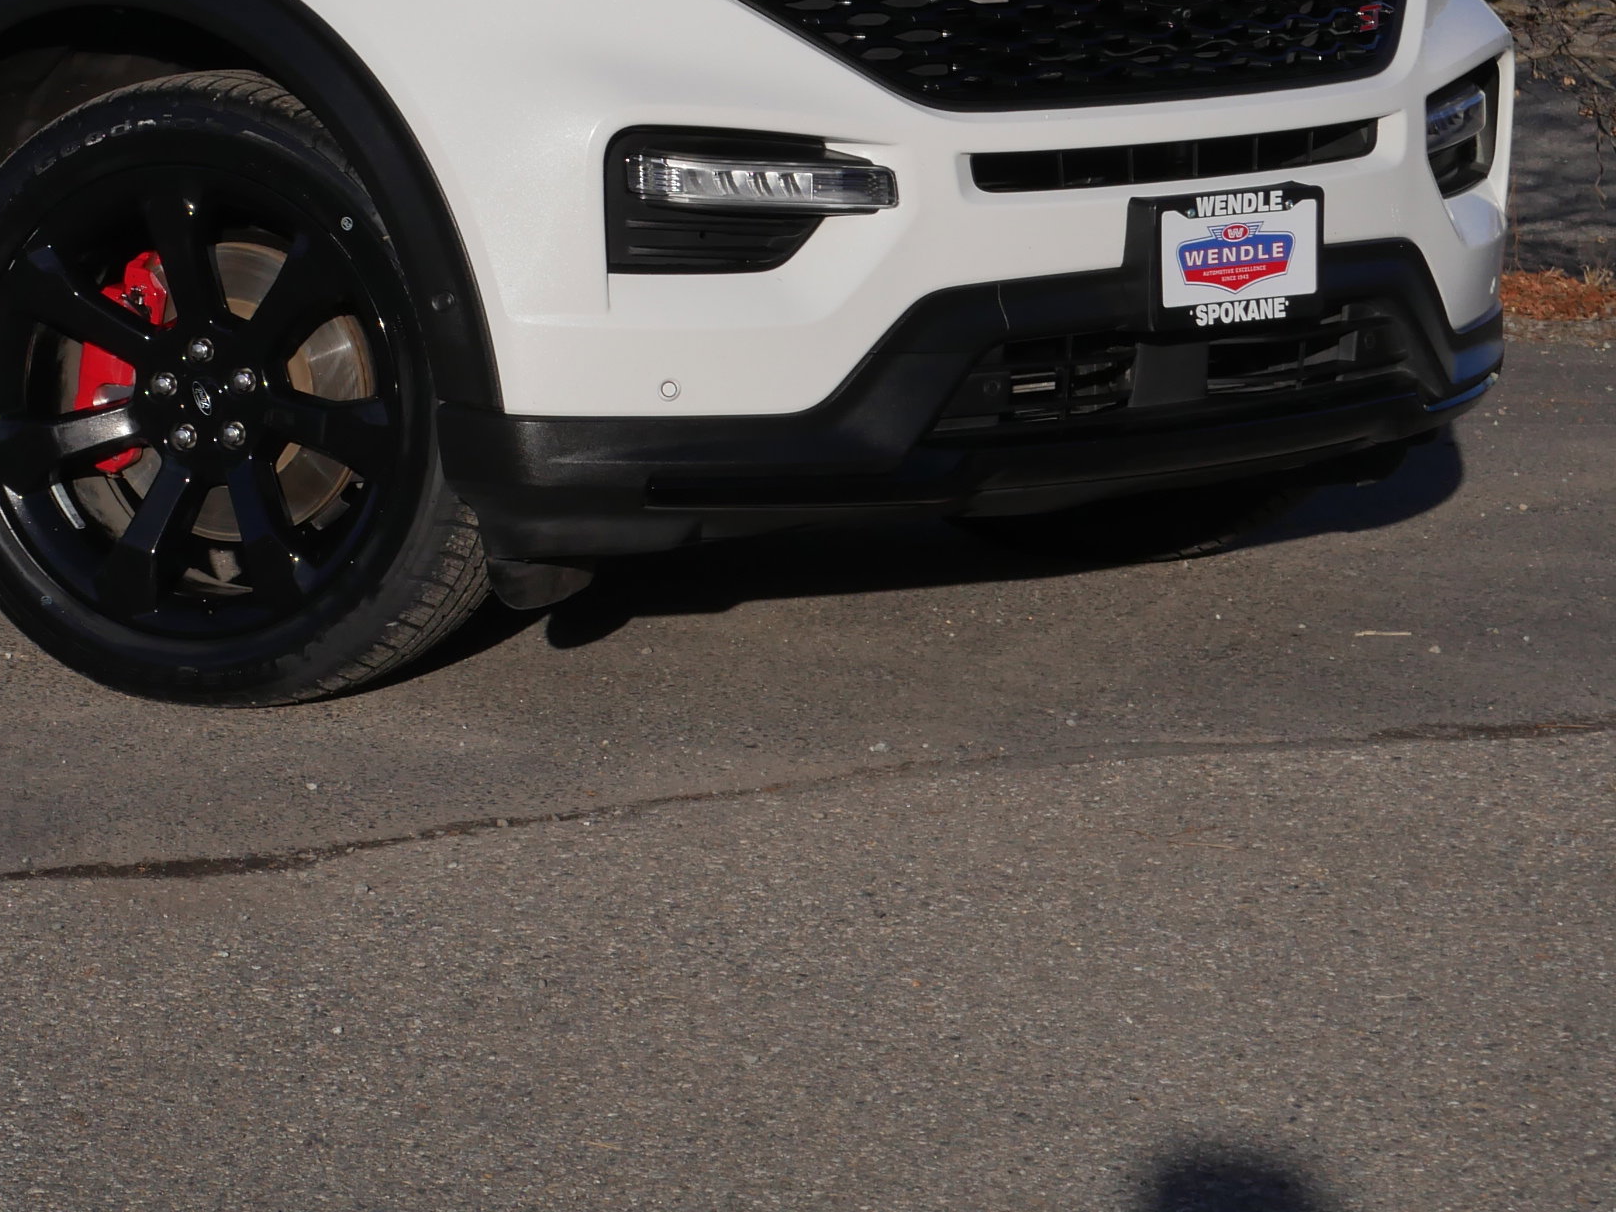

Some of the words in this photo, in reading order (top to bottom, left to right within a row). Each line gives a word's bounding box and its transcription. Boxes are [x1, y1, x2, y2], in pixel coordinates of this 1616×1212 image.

[1196, 190, 1283, 217] WENDLE
[1184, 242, 1284, 266] WENDLE
[1203, 268, 1234, 277] AUTOMOTIVE
[1235, 265, 1267, 274] EXCELLENCE
[1195, 297, 1286, 326] SPOKANE
